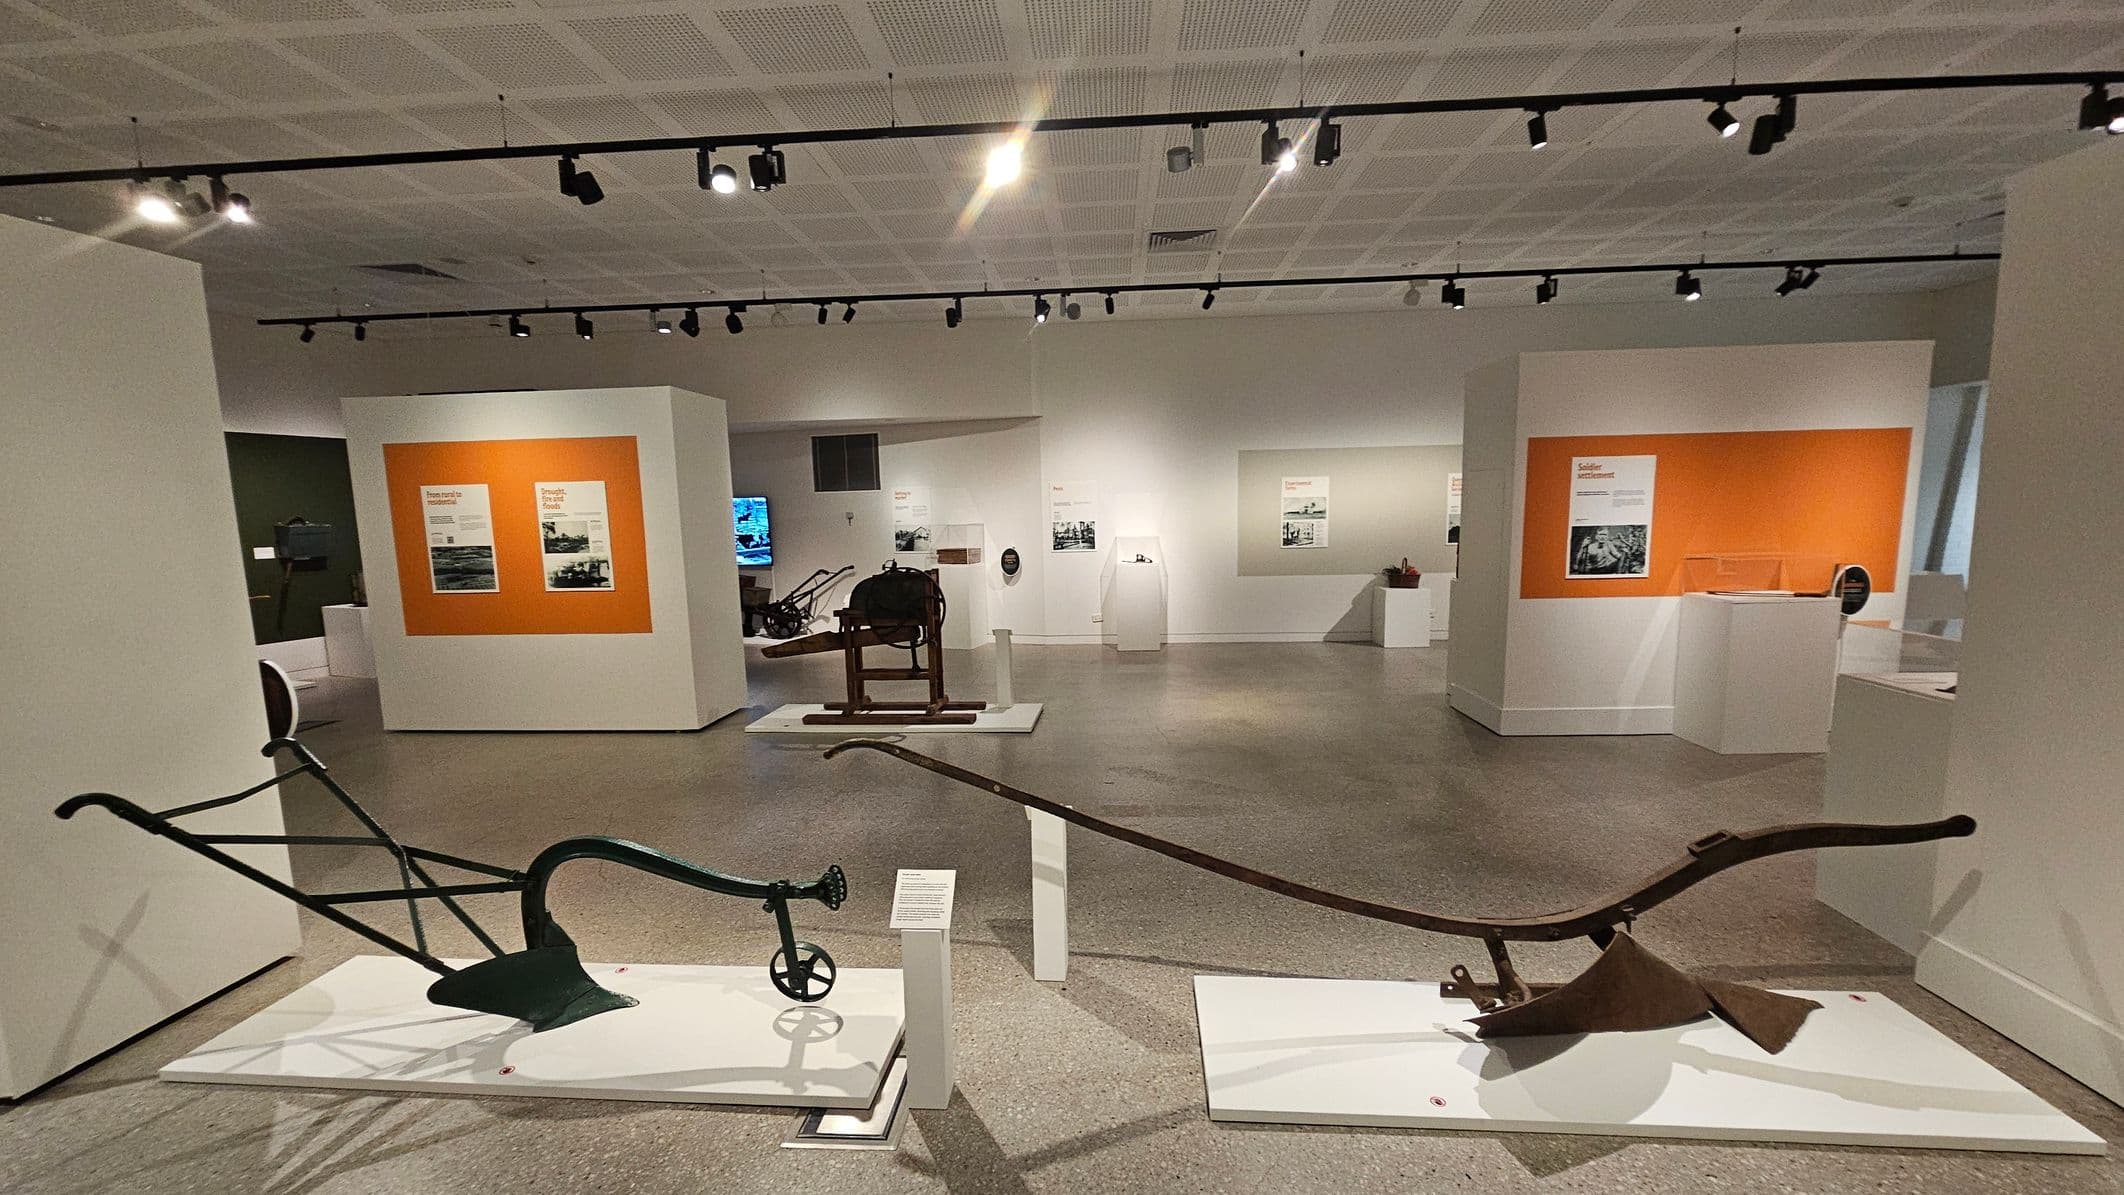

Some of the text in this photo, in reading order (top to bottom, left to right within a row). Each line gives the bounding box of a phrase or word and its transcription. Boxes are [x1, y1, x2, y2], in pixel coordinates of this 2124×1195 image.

[1578, 462, 1603, 471] Soldier
[1577, 471, 1615, 479] settlement
[426, 490, 440, 498] From
[441, 490, 455, 498] rural
[427, 497, 457, 505] residential
